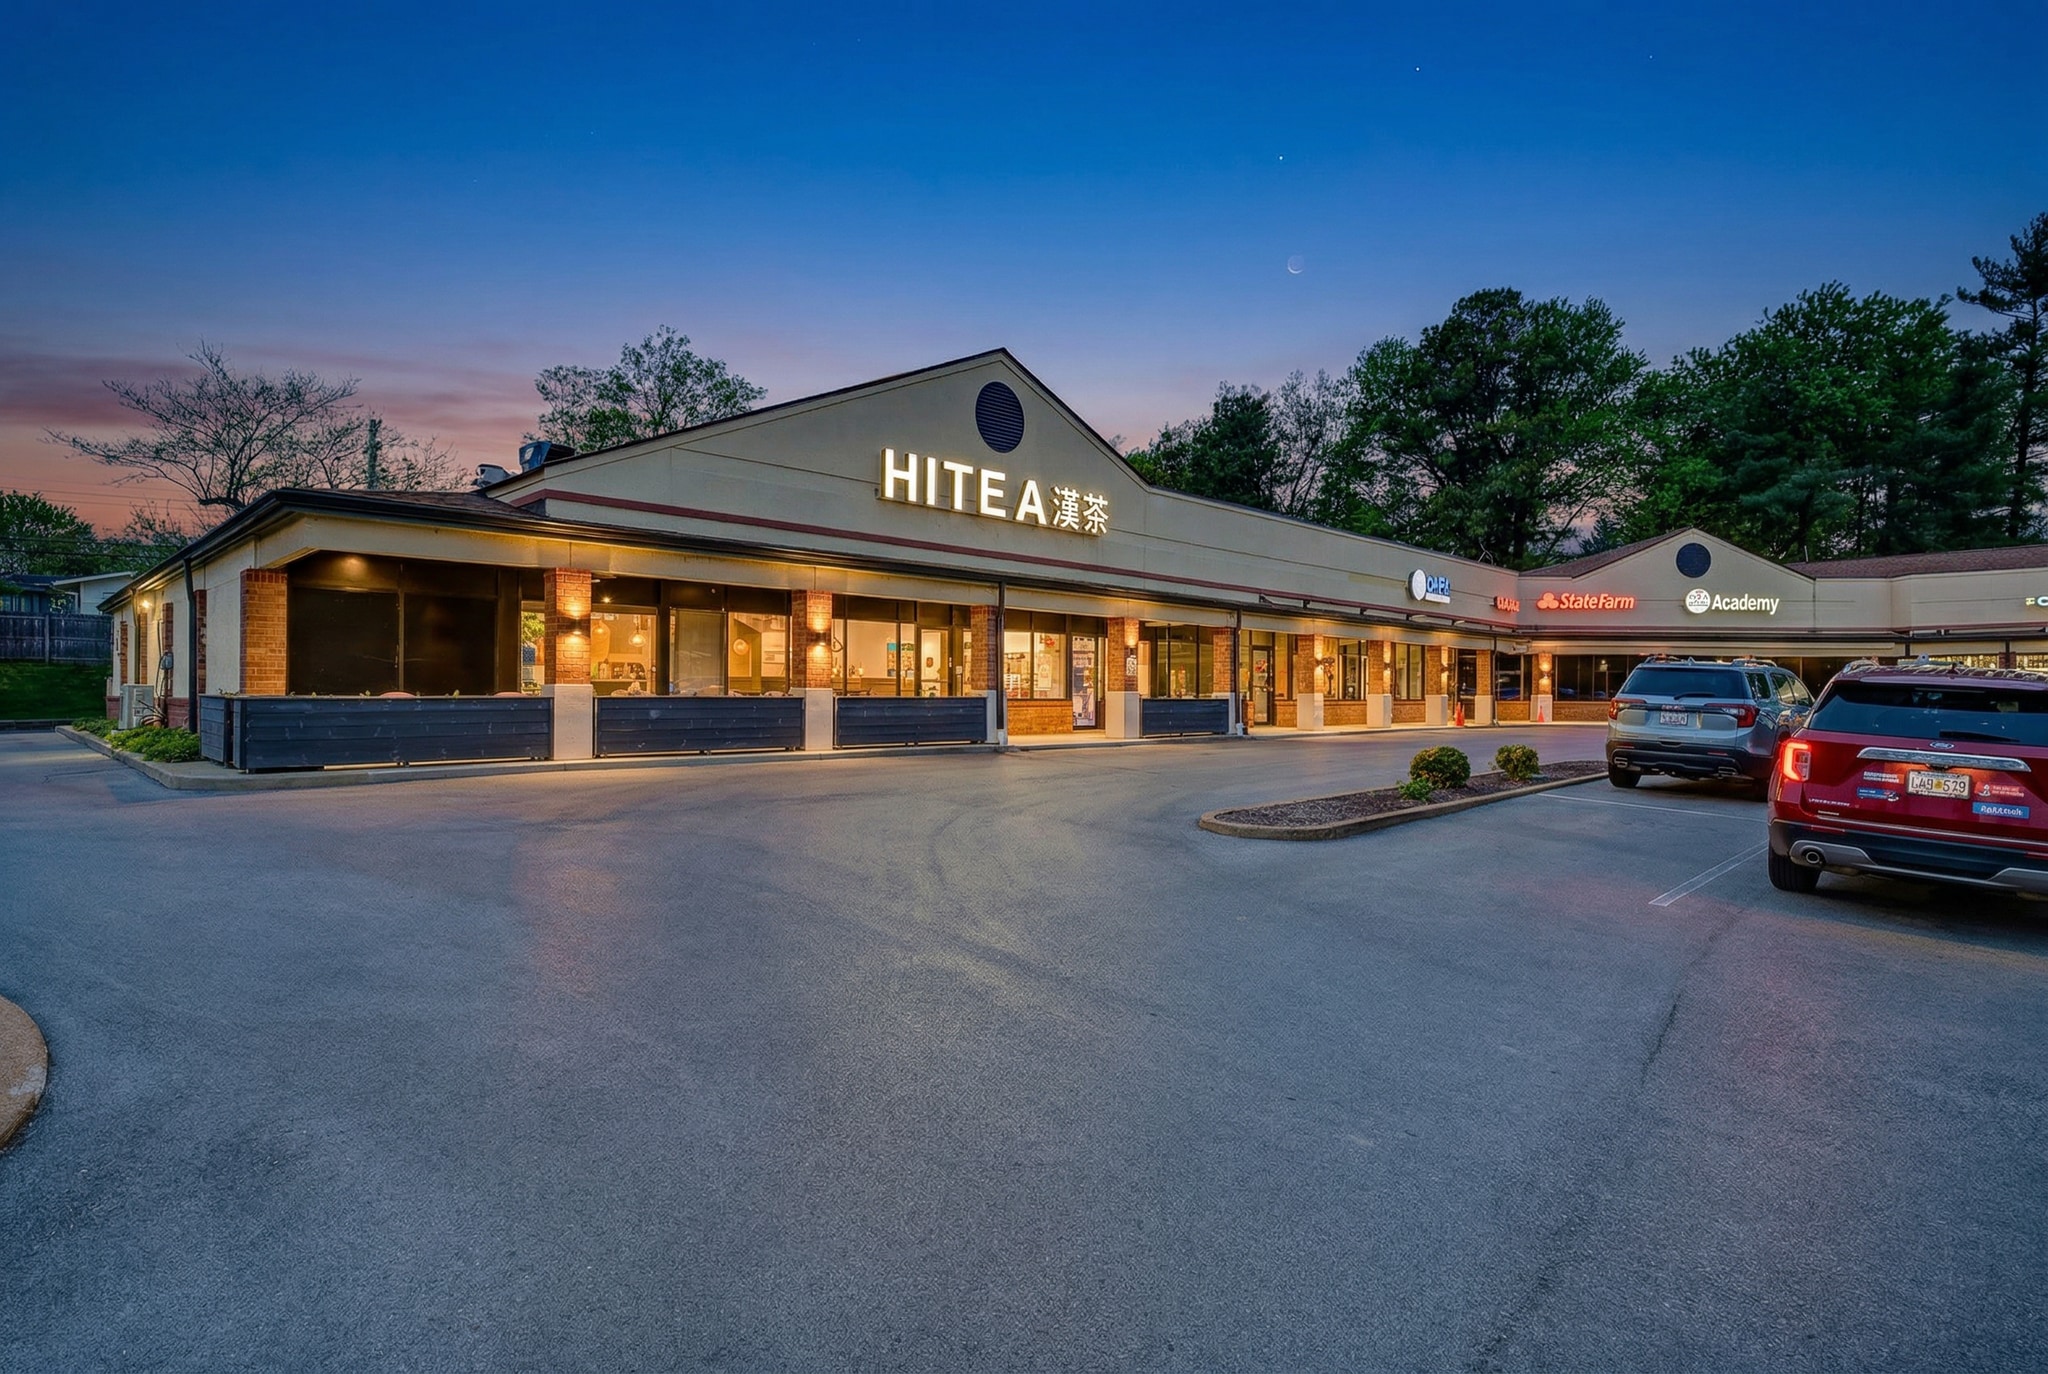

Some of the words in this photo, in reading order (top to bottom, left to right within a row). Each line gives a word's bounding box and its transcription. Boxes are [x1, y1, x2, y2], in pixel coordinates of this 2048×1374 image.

[881, 448, 1047, 525] HITEA
[1051, 485, 1109, 534] 漢茶
[1711, 593, 1779, 615] Academy
